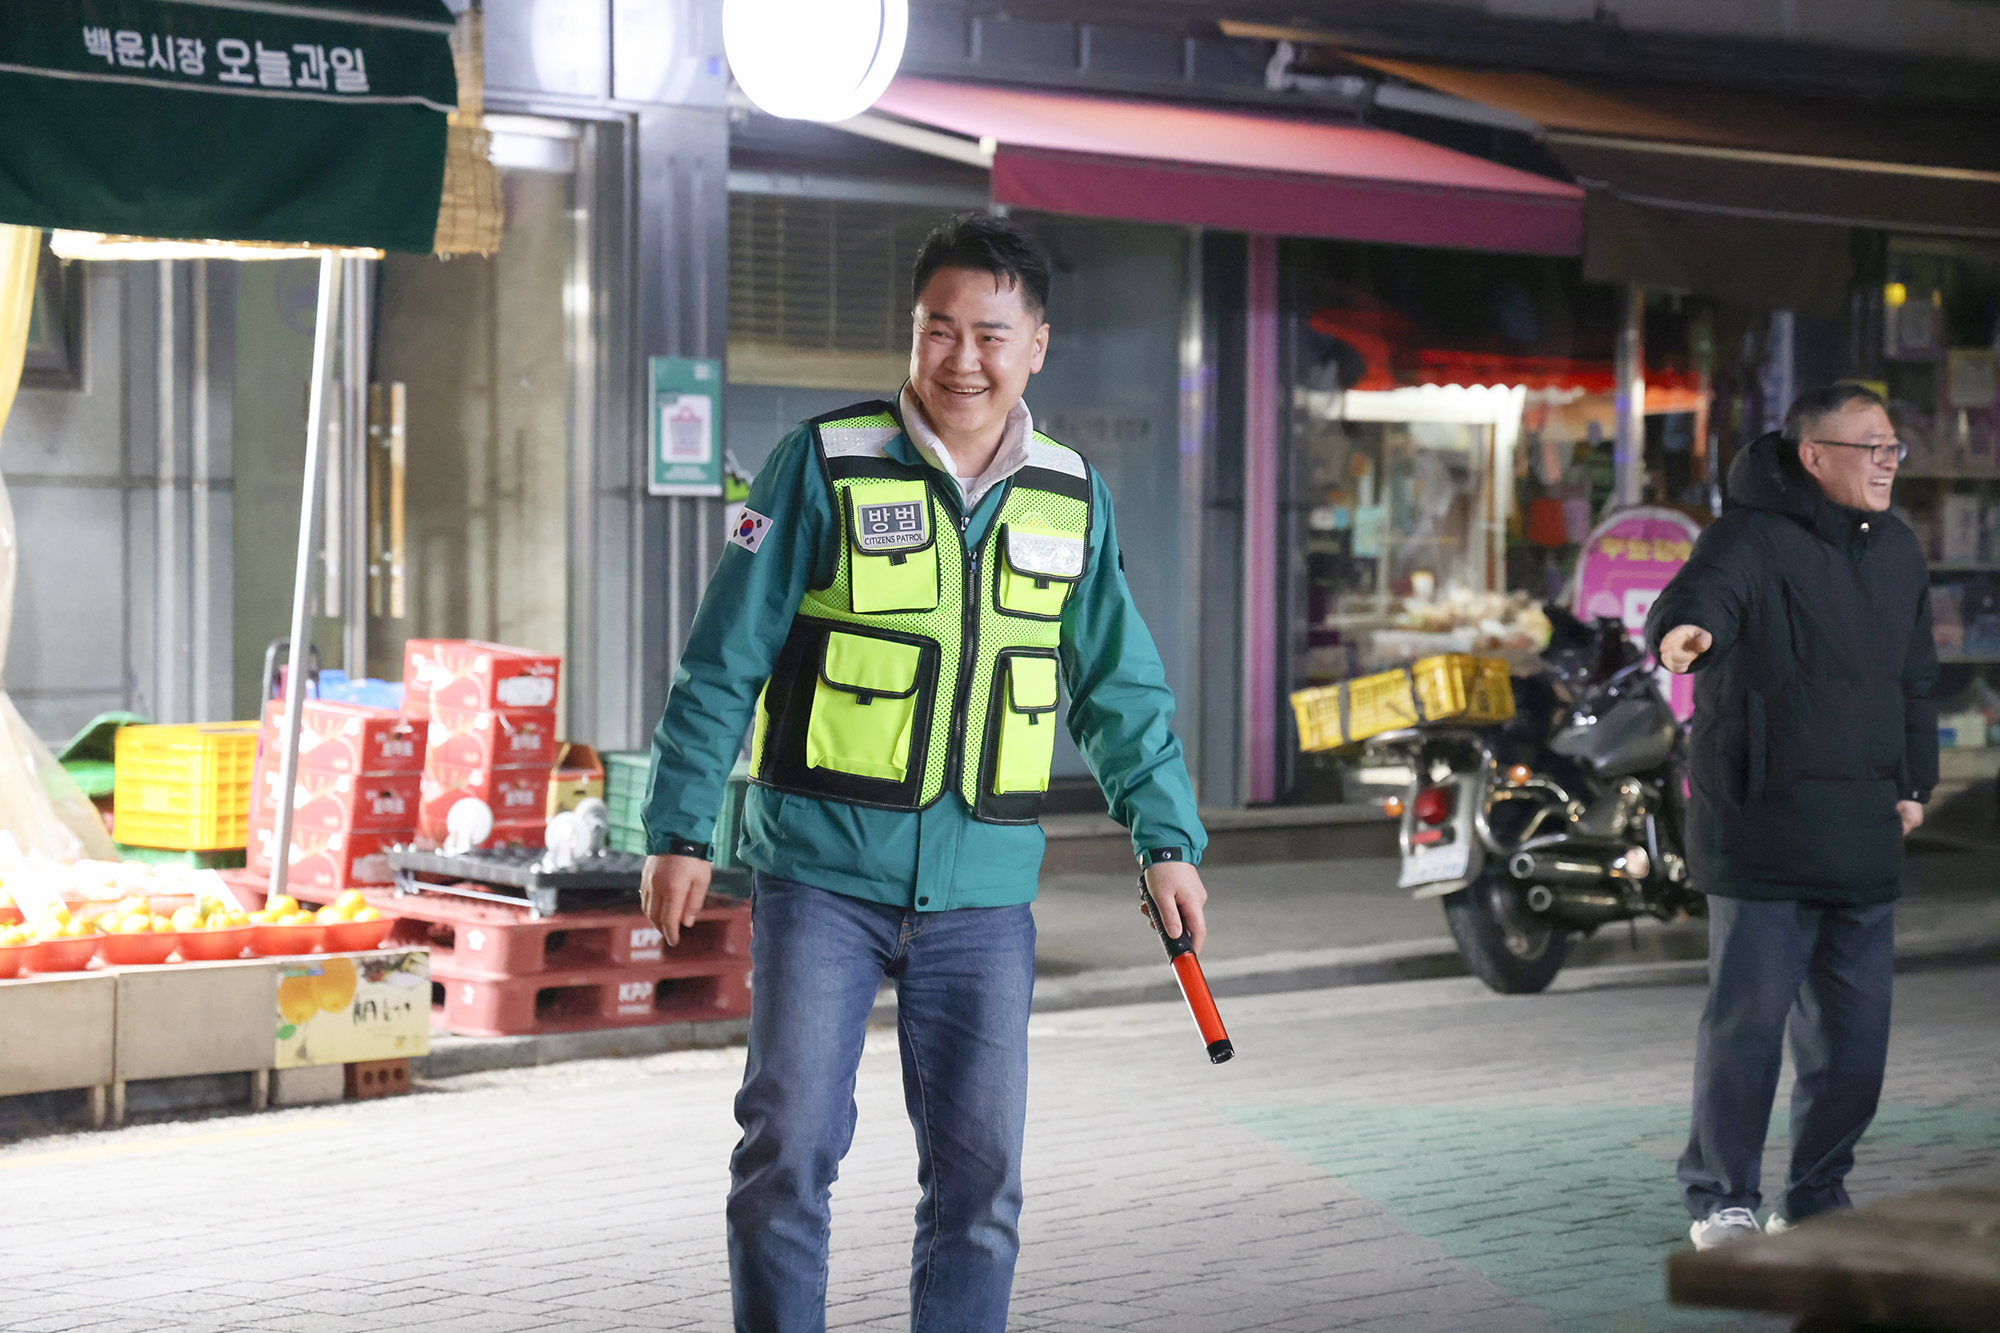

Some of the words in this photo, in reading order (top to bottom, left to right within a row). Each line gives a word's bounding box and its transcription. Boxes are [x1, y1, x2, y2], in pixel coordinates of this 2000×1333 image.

[82, 25, 205, 76] 백운시장
[216, 37, 370, 93] 오늘과일
[868, 505, 916, 533] 방범
[864, 536, 895, 545] CITIZENS
[896, 533, 923, 543] PATROL
